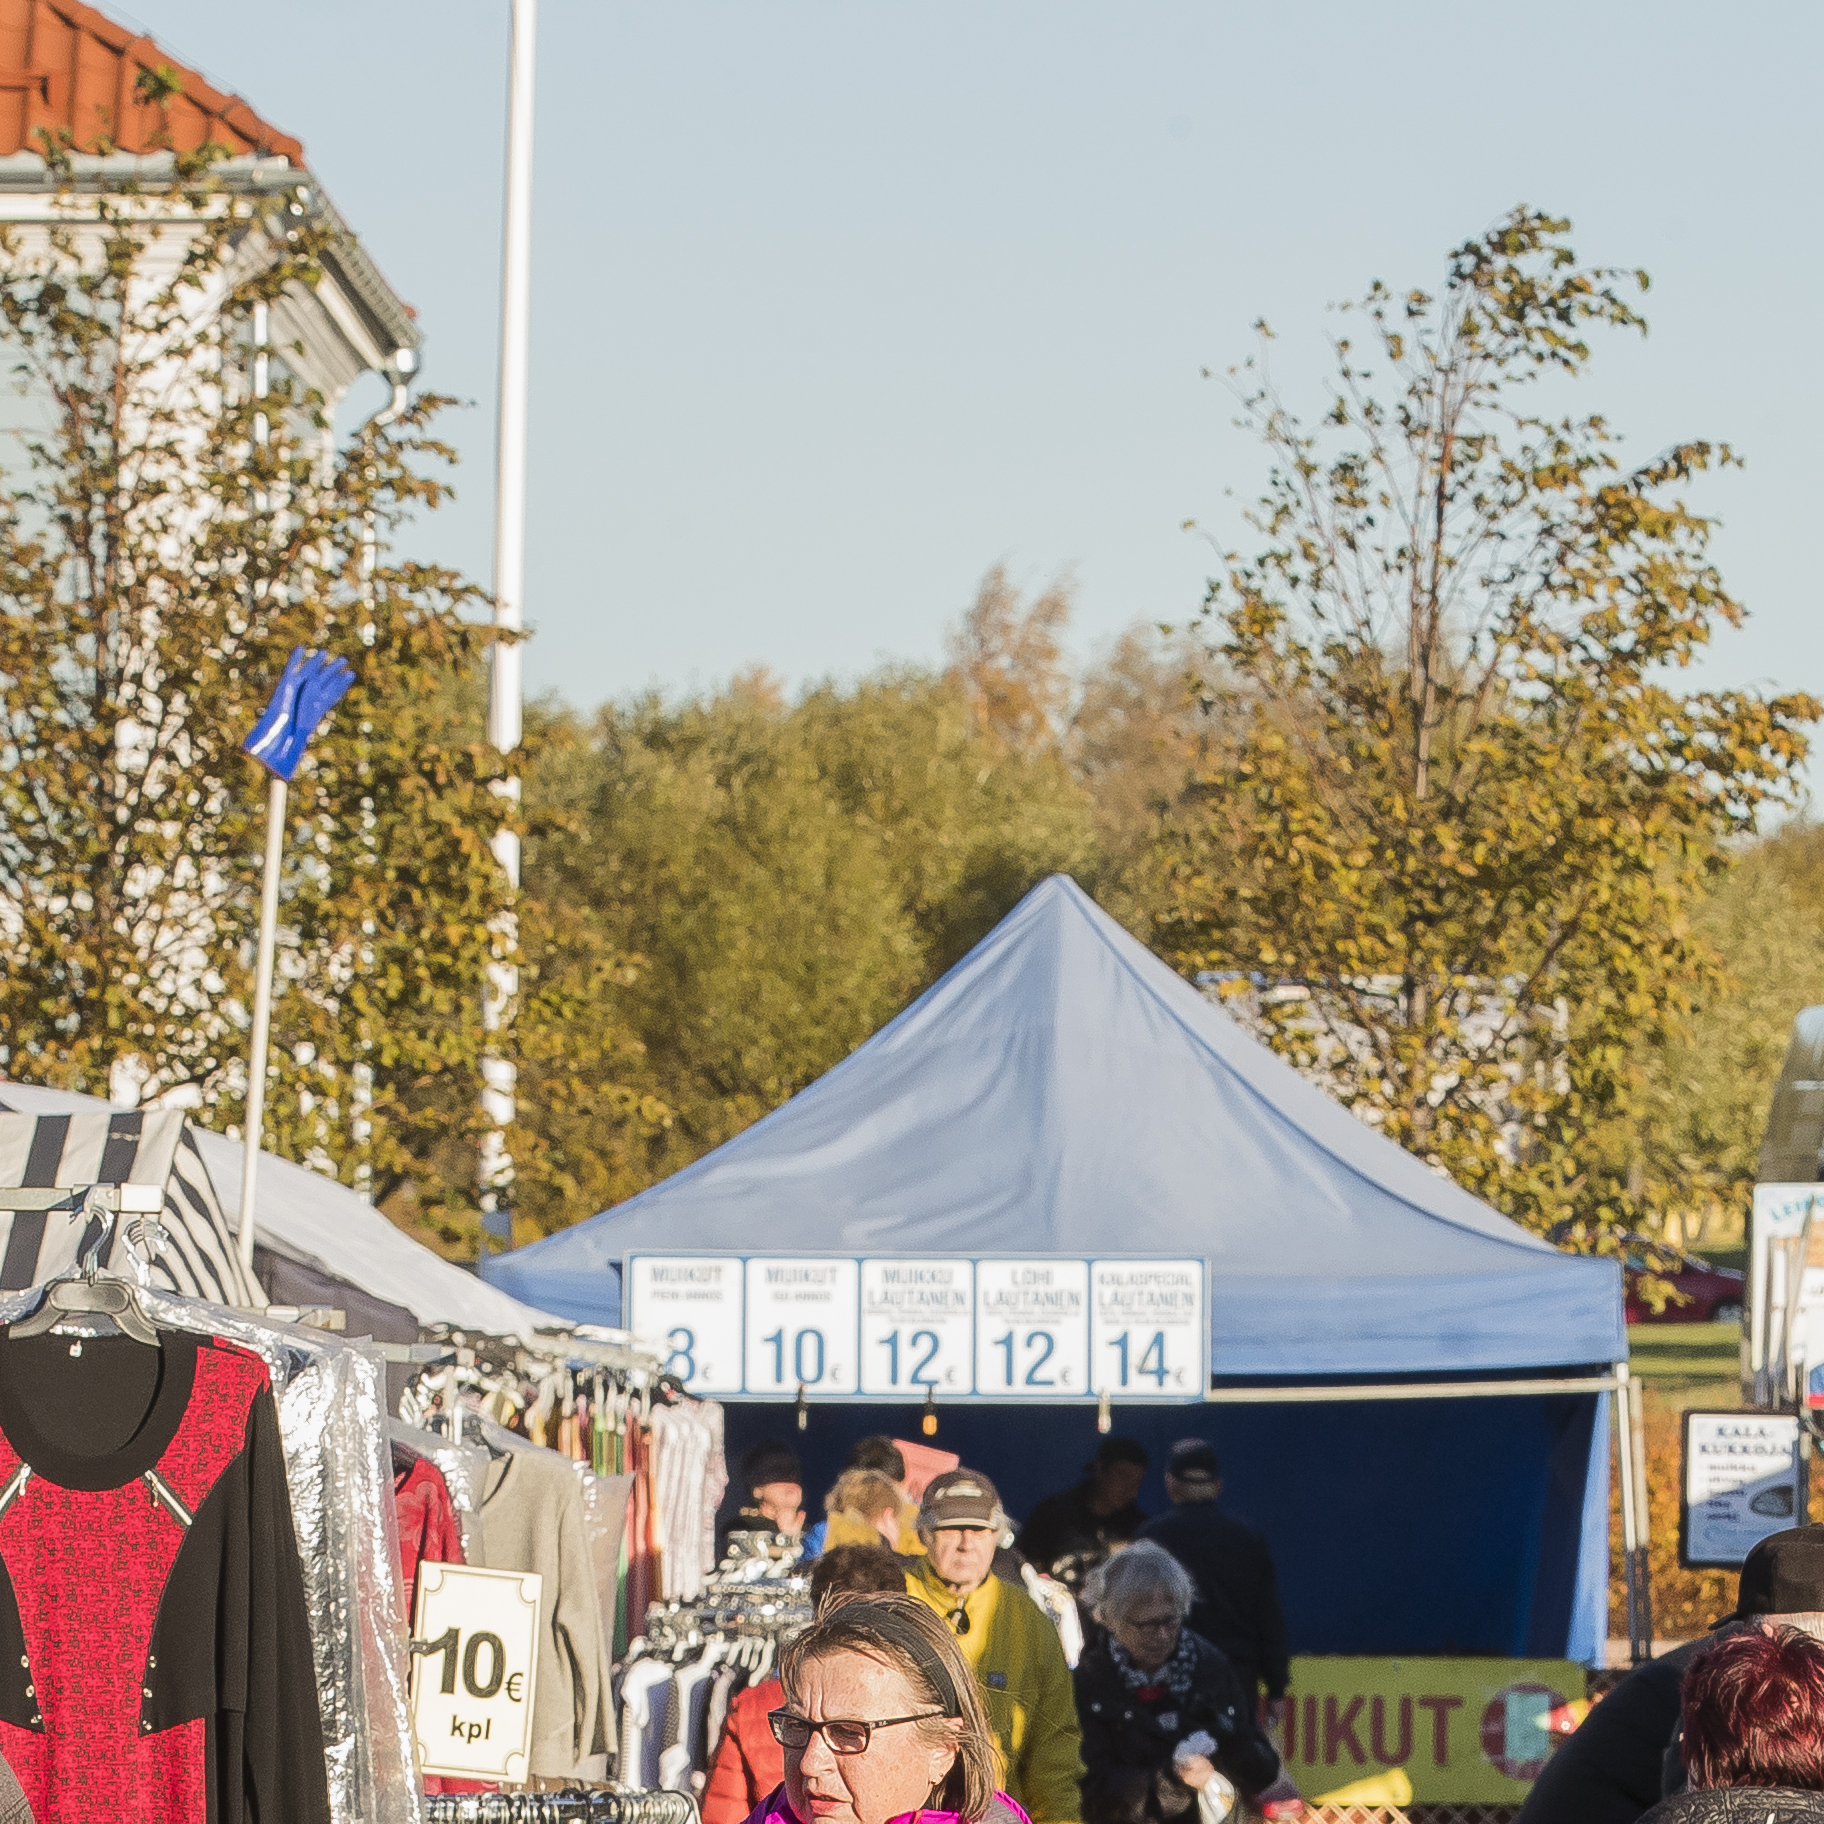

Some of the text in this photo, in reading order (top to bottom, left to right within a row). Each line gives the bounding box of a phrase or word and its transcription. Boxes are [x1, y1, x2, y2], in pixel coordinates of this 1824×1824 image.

[651, 1266, 724, 1284] MUIKUT
[766, 1267, 838, 1285] MUIKUT
[881, 1267, 954, 1286] MUIKKU
[868, 1288, 965, 1309] LAUTANEN
[984, 1289, 1081, 1309] LAUTANEN
[1098, 1289, 1194, 1310] LAUTANEN
[449, 1714, 492, 1744] kpl
[1256, 1694, 1464, 1766] UIKUT
